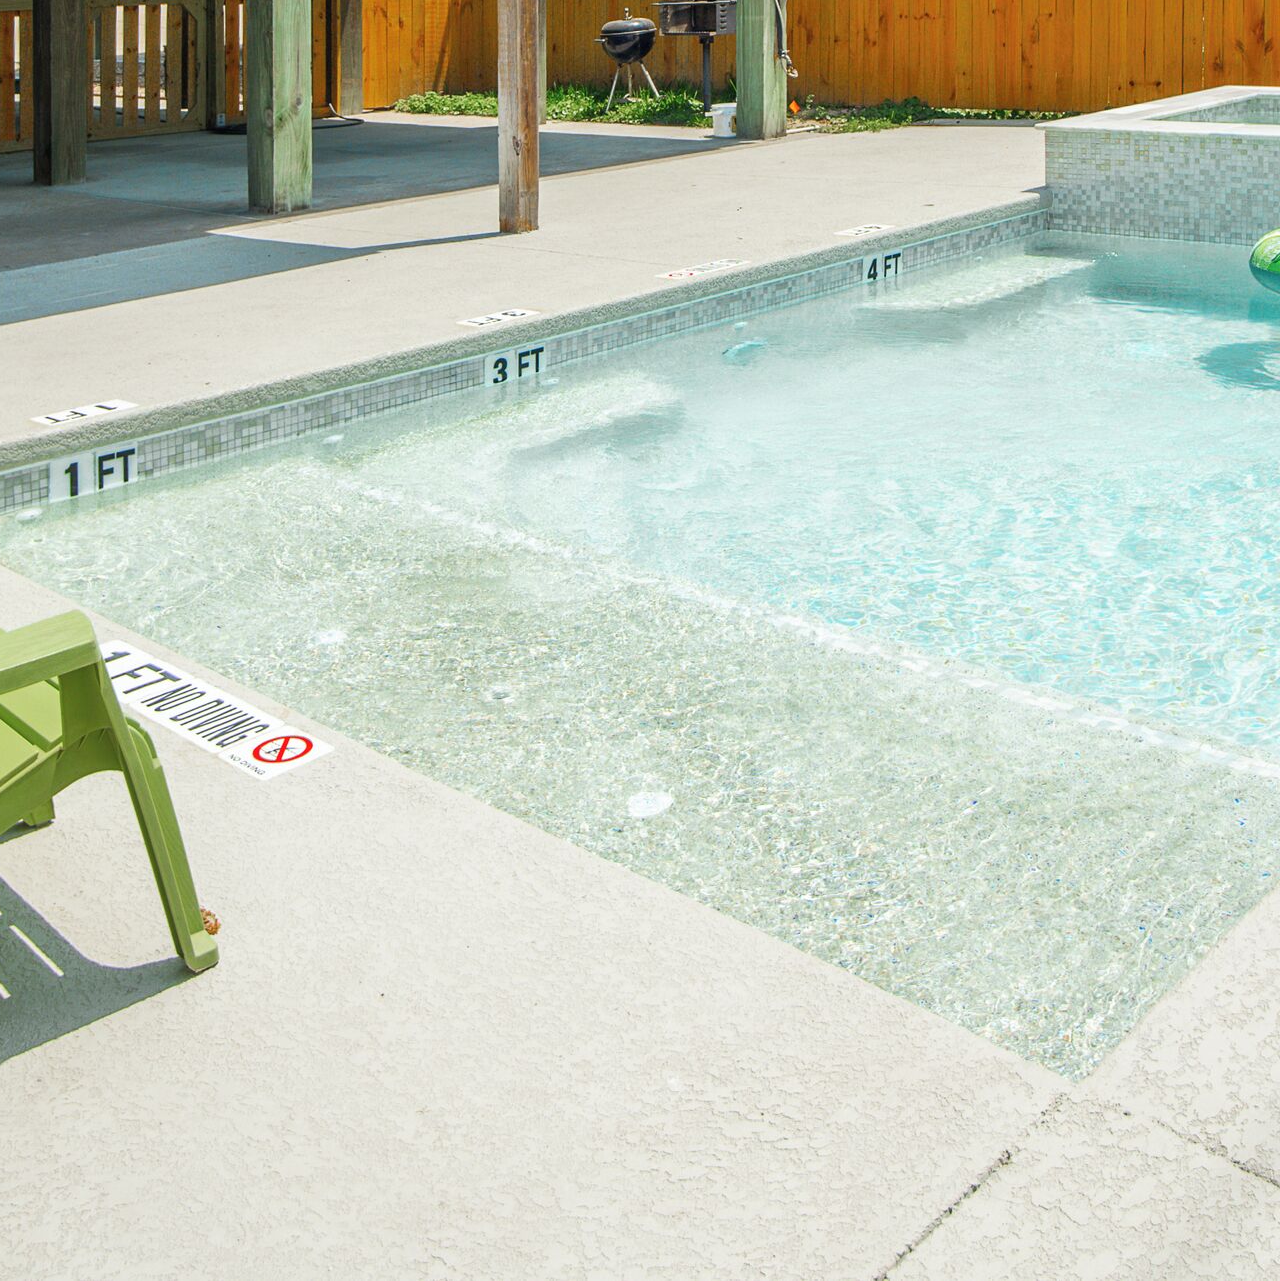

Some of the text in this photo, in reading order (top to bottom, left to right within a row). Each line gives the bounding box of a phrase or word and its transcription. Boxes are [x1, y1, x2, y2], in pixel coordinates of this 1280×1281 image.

[868, 252, 902, 280] 4 FT
[493, 346, 544, 384] 3 FT
[44, 411, 87, 424] FT
[65, 447, 135, 497] 1 FT
[104, 651, 270, 748] 1 FT NO DIVING
